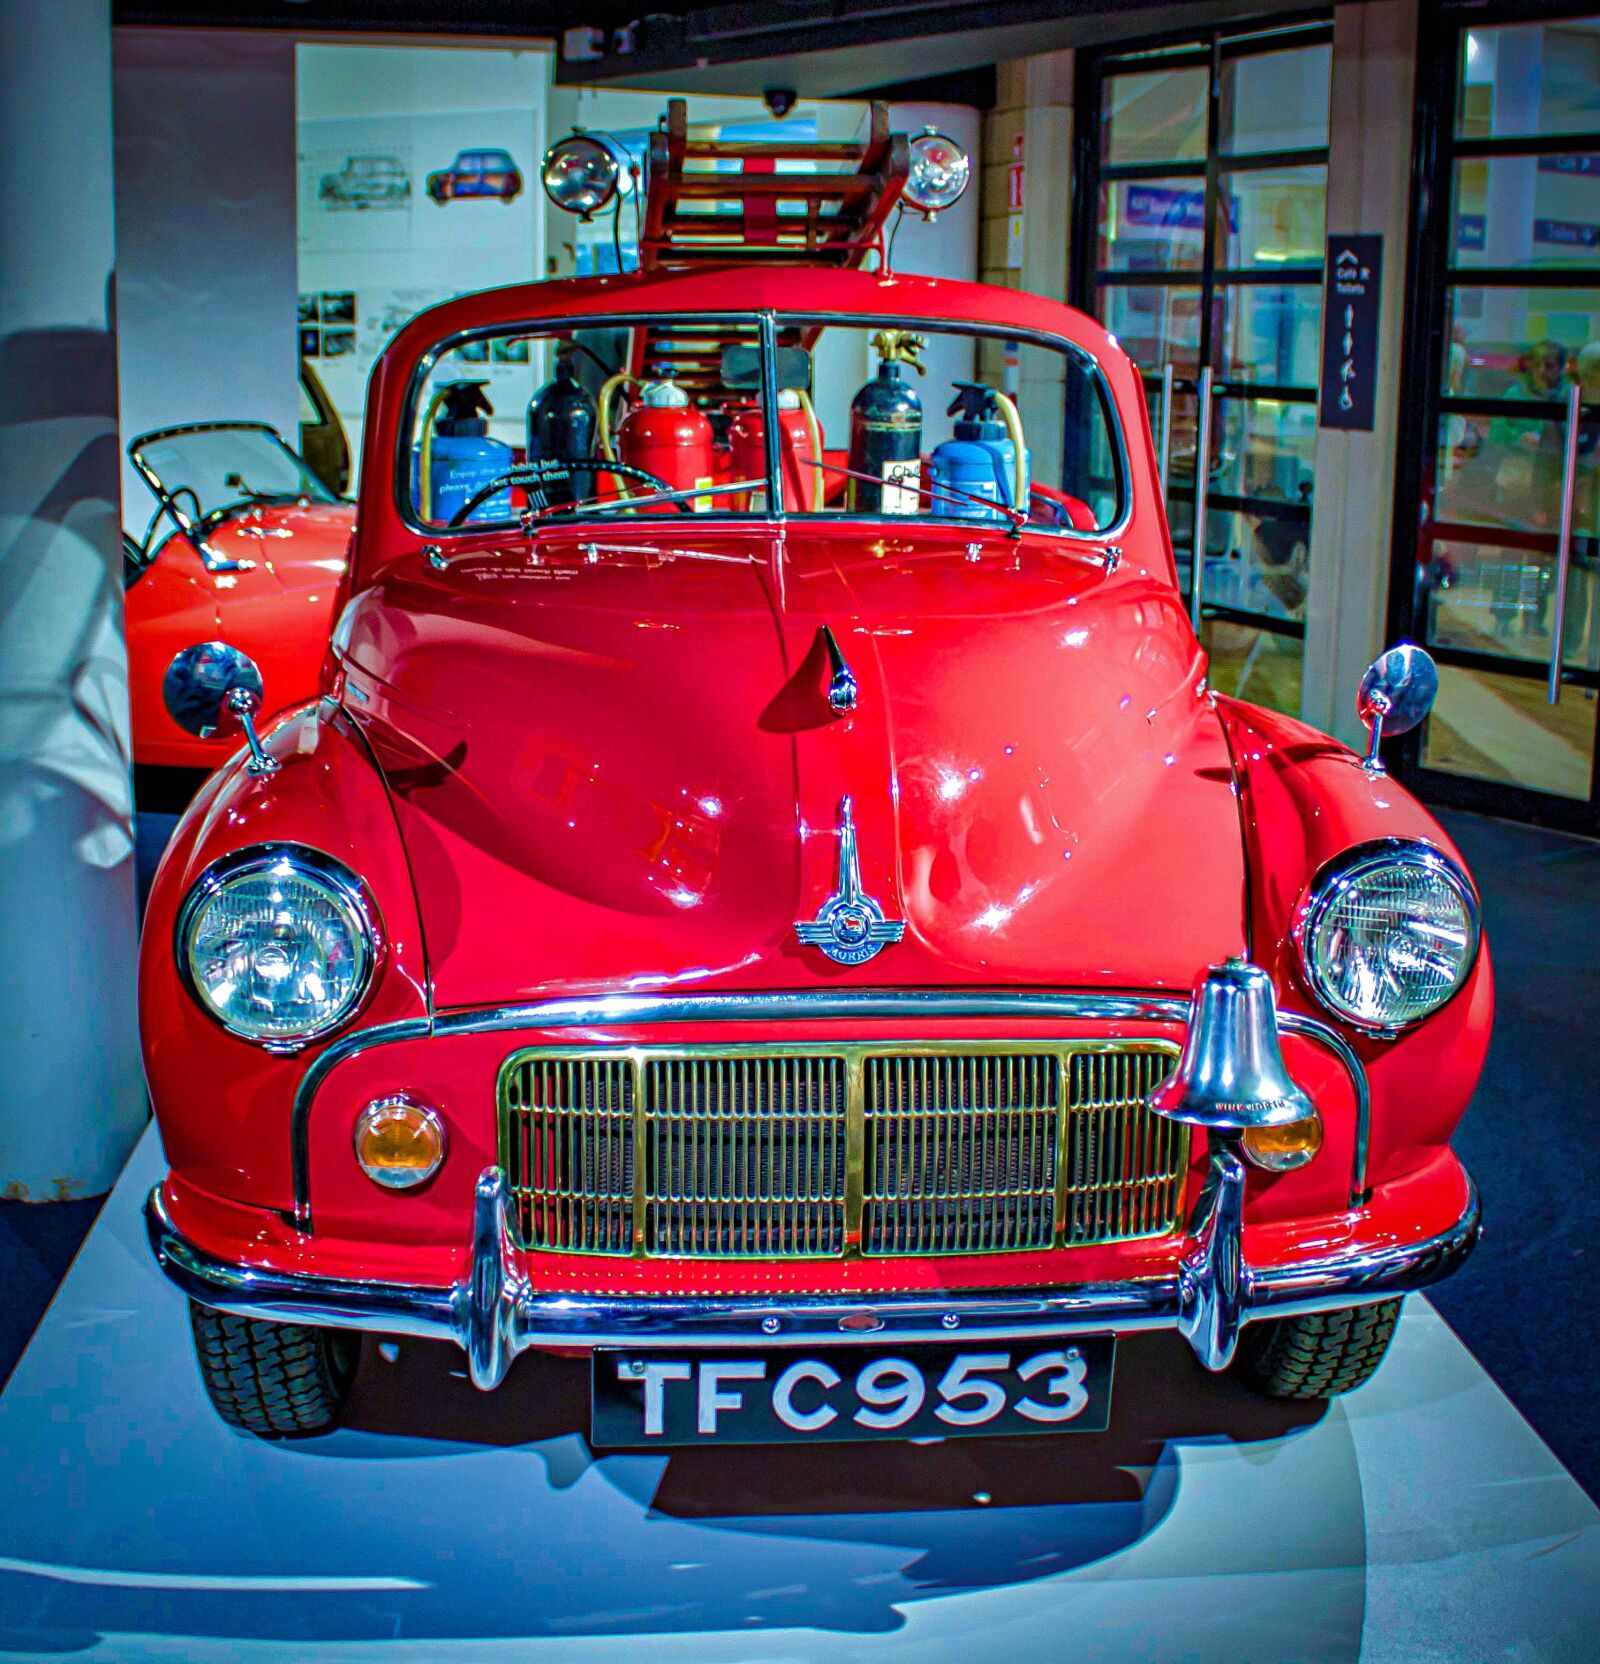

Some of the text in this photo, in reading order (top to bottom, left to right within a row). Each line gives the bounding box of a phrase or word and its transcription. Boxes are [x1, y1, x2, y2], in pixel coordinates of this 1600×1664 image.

[1336, 283, 1365, 295] Toilets
[540, 458, 560, 470] but
[511, 472, 540, 485] touch
[542, 470, 570, 482] them
[827, 943, 875, 961] MORRIS
[616, 1352, 1090, 1435] TFC953
